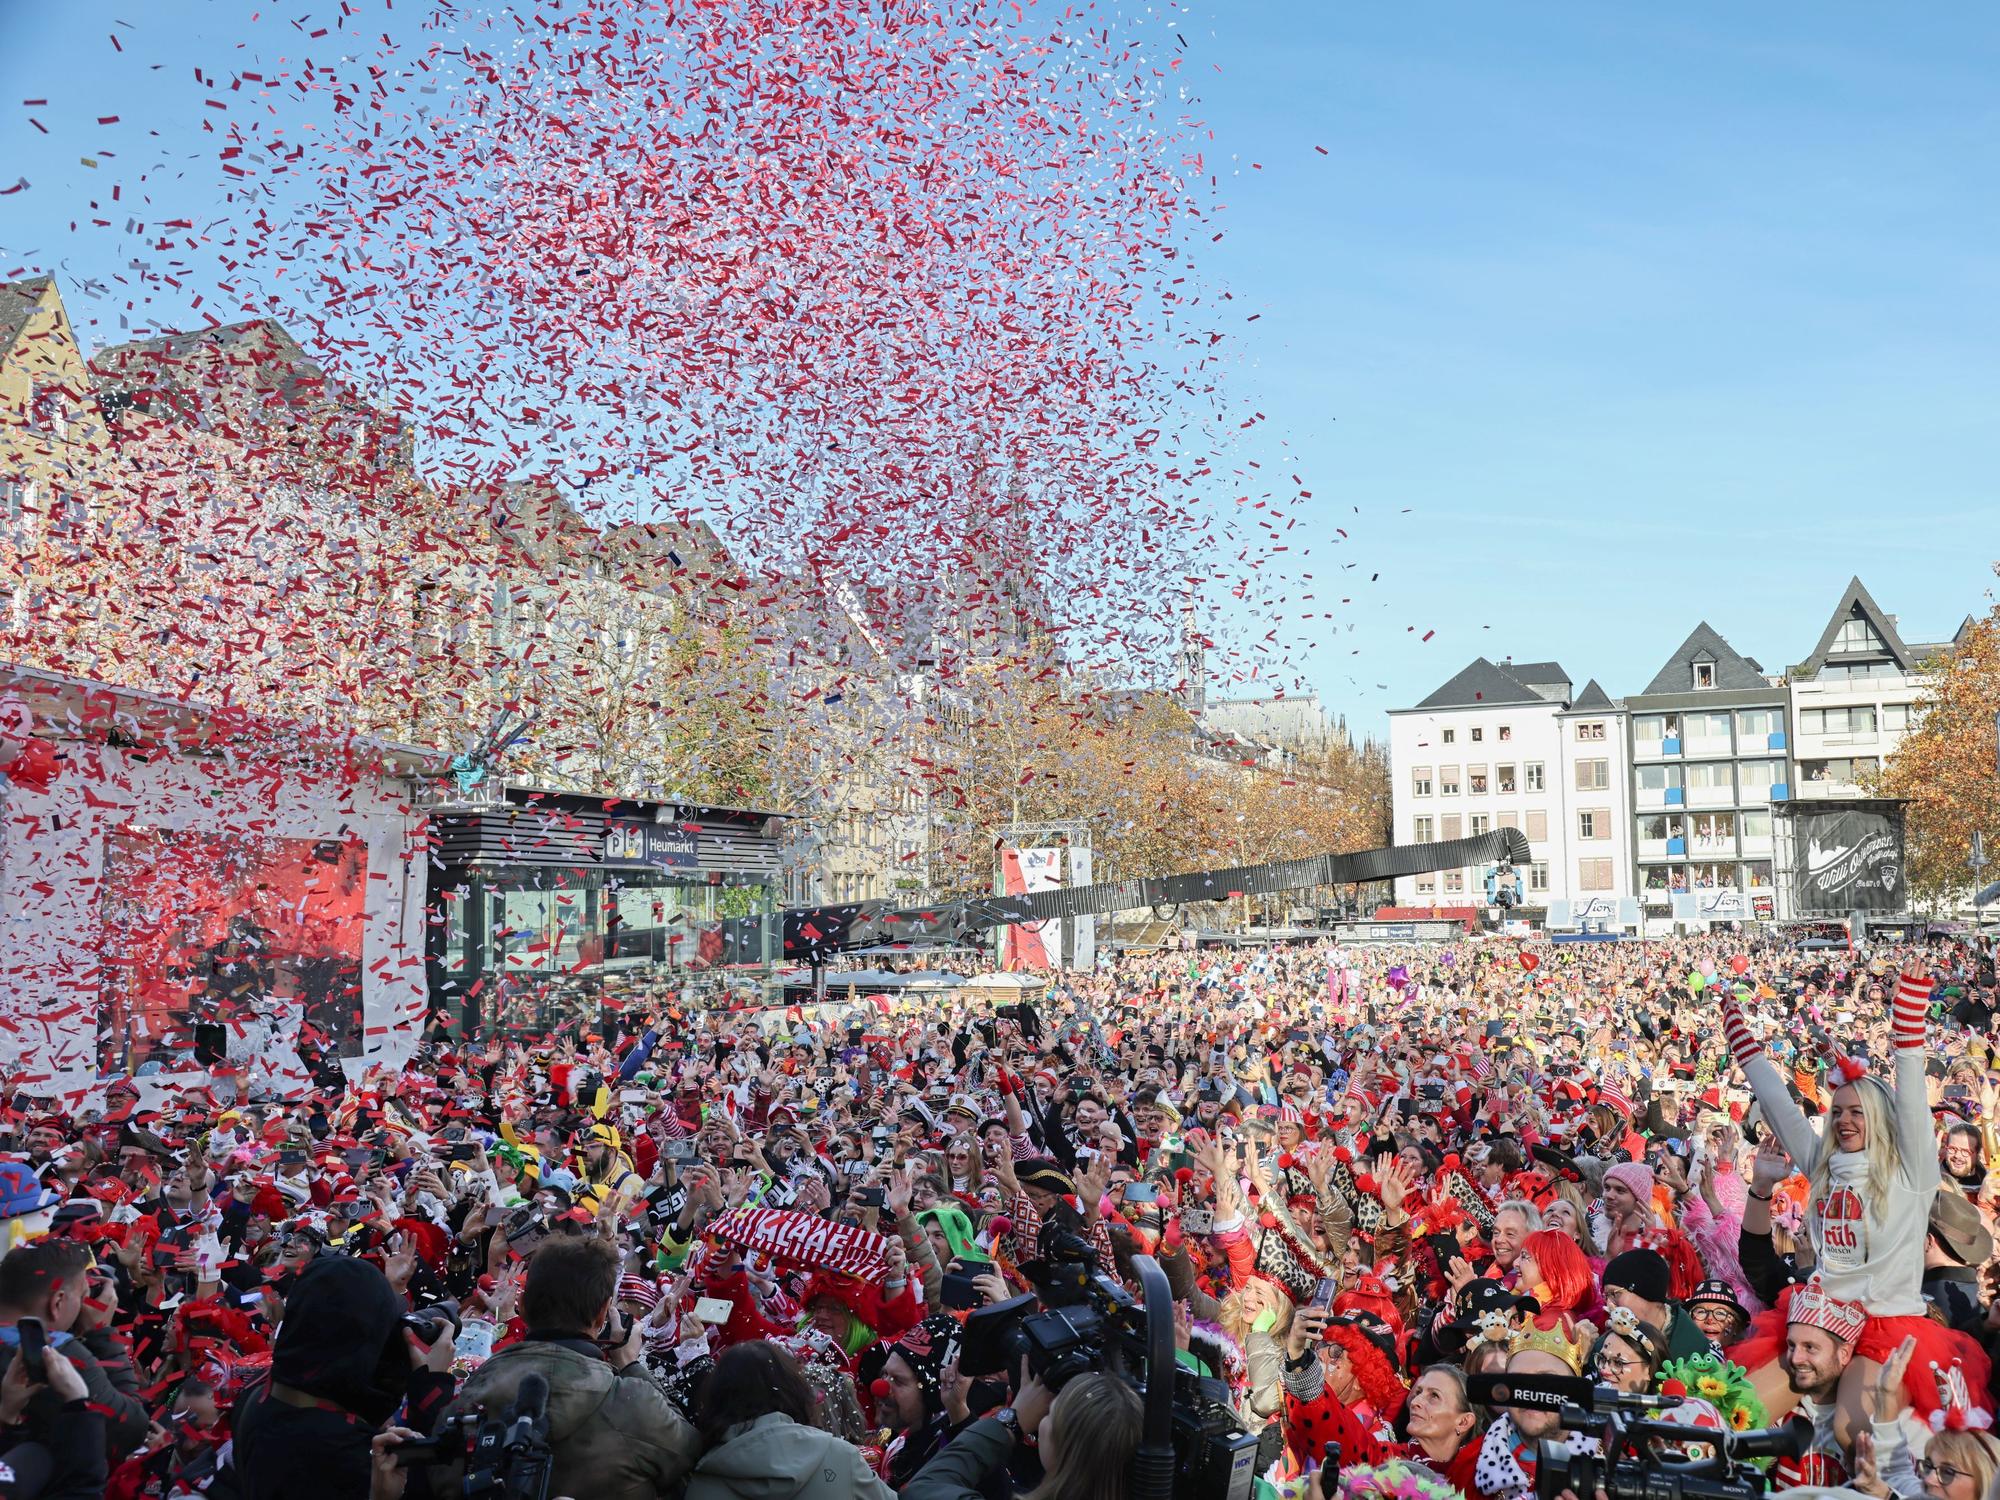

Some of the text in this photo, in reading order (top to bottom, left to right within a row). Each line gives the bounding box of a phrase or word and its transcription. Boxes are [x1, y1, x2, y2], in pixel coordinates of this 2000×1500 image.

[650, 837, 694, 854] Heumarkt
[1818, 862, 1848, 890] Willi
[1577, 898, 1612, 917] Sion
[1703, 891, 1741, 911] Sion
[1824, 1224, 1857, 1249] rüh
[1514, 1389, 1569, 1405] REUTERS
[1722, 1485, 1749, 1494] SONY
